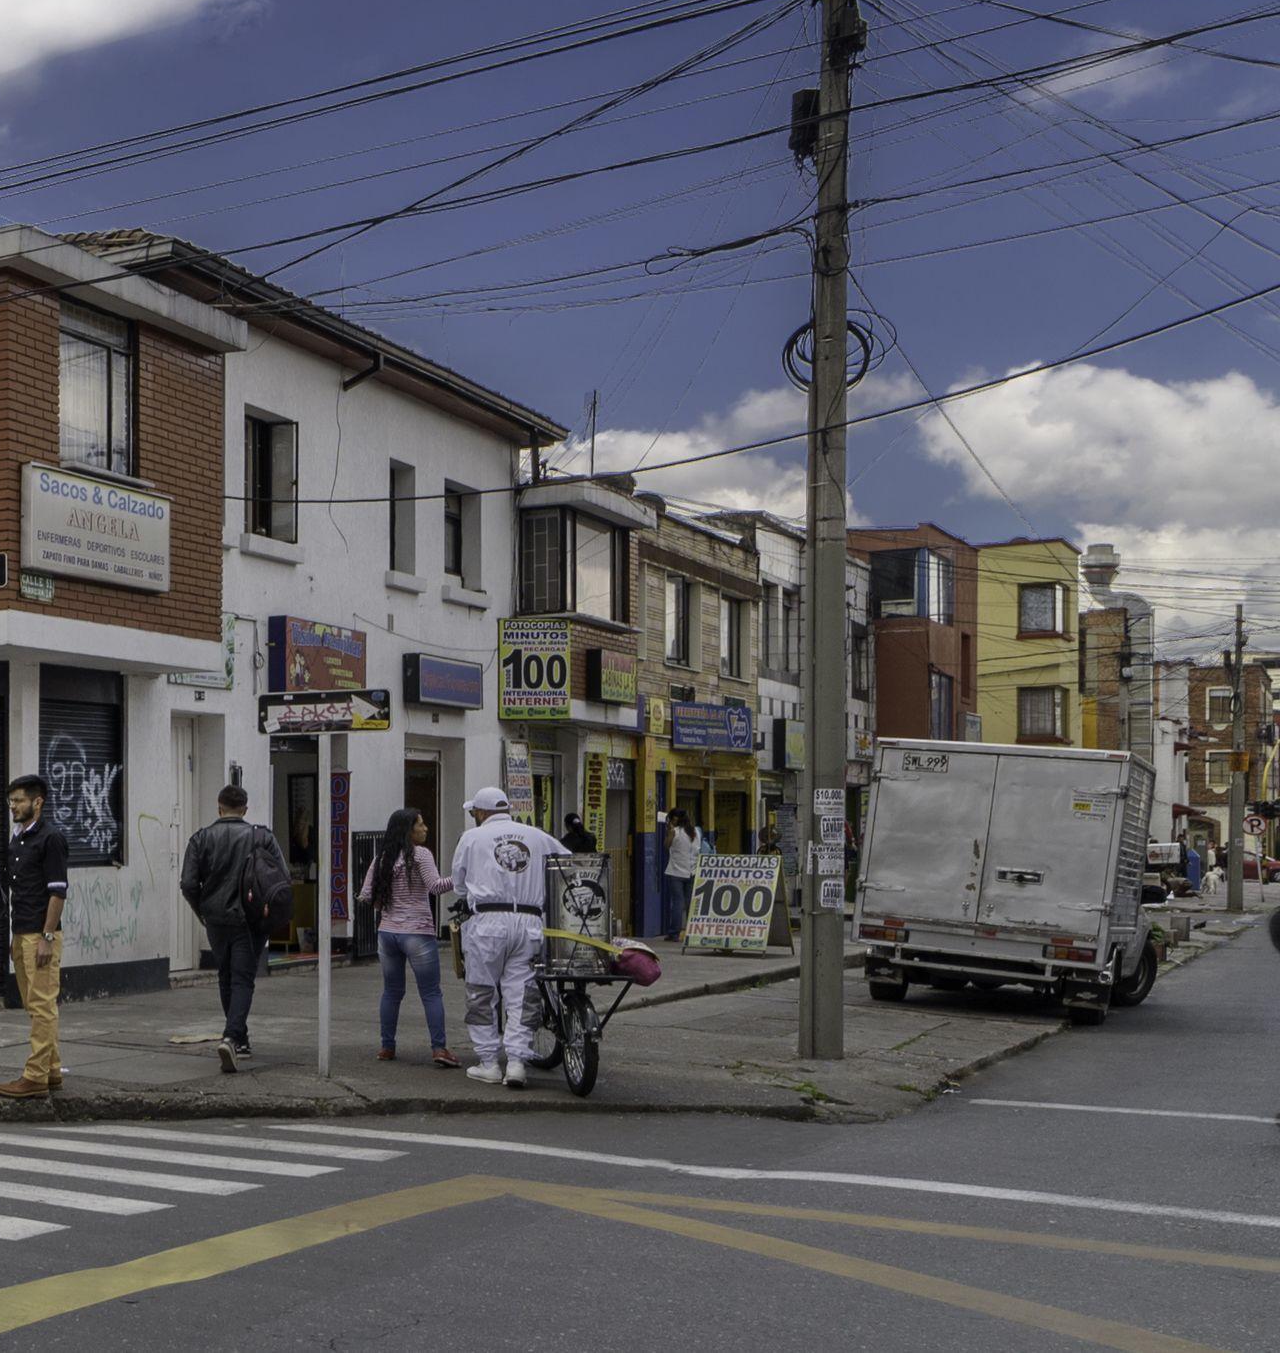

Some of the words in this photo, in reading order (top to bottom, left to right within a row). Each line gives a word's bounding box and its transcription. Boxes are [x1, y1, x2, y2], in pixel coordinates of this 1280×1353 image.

[40, 472, 88, 503] Sacos
[92, 486, 104, 506] &
[107, 489, 164, 520] Calzado
[66, 507, 140, 542] ANGELA
[37, 529, 82, 550] ENFERMERAS
[86, 540, 126, 558] DEPORTIVOS
[130, 549, 165, 566] ESCOLARES
[504, 621, 567, 630] FOTOCOPIAS
[503, 631, 568, 640] MINUTOS
[502, 649, 567, 689] 100
[502, 697, 569, 706] INTERNET
[1250, 818, 1261, 833] P
[330, 775, 348, 918] OPTICA
[700, 856, 778, 868] FOTOCOPIAS
[700, 869, 775, 880] MINUTOS
[694, 880, 773, 918] 100
[690, 917, 768, 926] INTERNACIONAL
[688, 923, 768, 938] INTERNET
